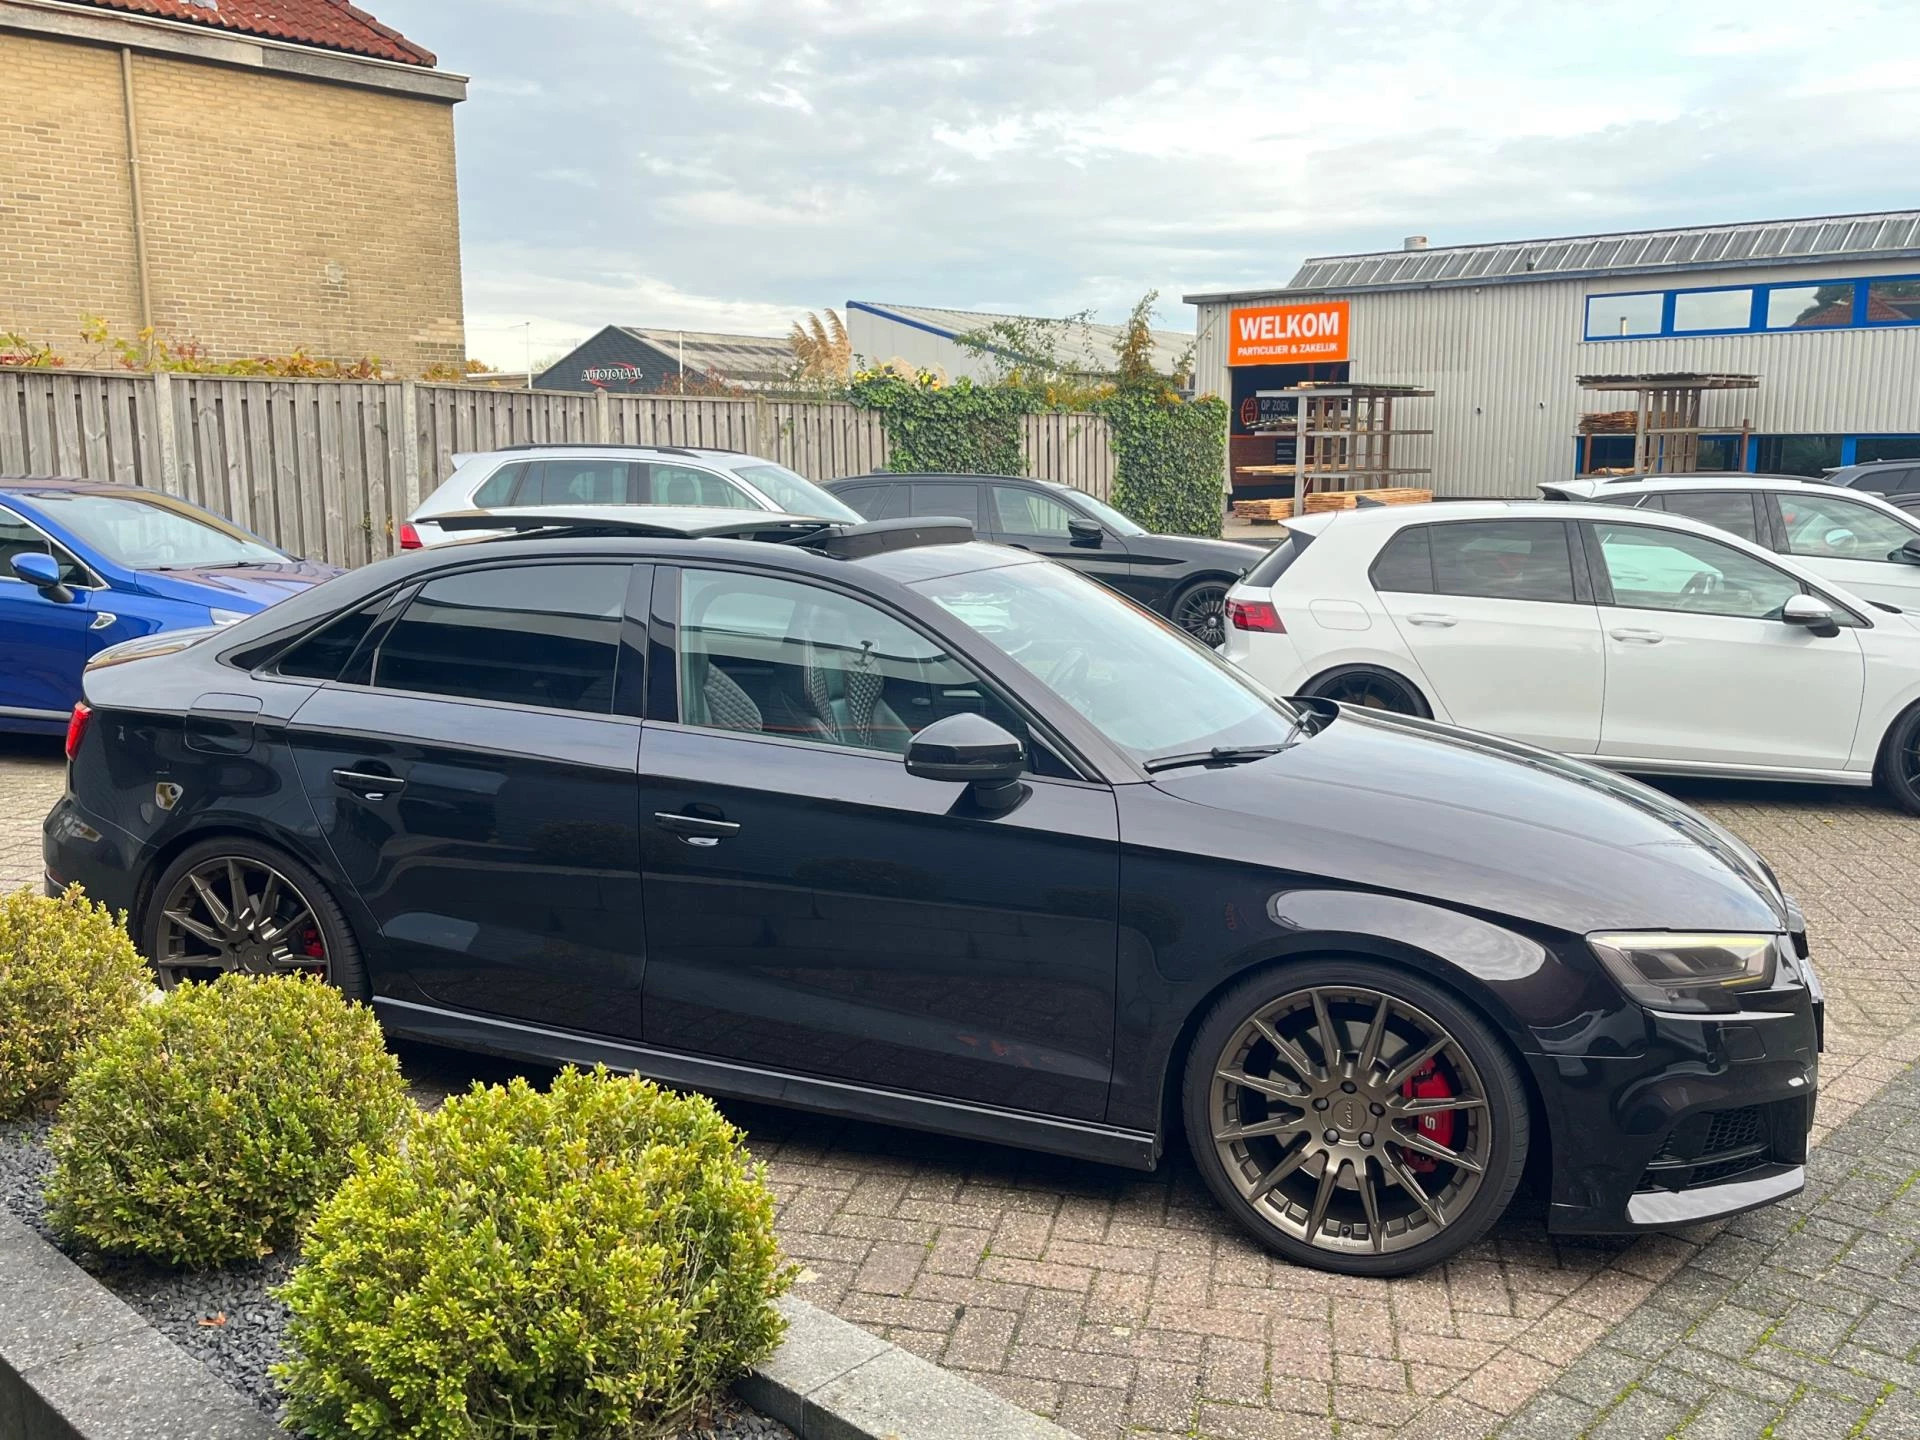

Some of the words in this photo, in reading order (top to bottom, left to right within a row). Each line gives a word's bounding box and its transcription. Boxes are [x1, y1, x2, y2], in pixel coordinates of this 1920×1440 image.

[1239, 311, 1339, 341] WELKOM
[1237, 344, 1289, 356] PARTICULIER
[1290, 344, 1298, 354] &
[1299, 342, 1338, 353] ZAKELIJK
[581, 367, 643, 381] AUTOTOTAAL
[1261, 400, 1270, 410] OP
[1272, 400, 1290, 411] ZOEK
